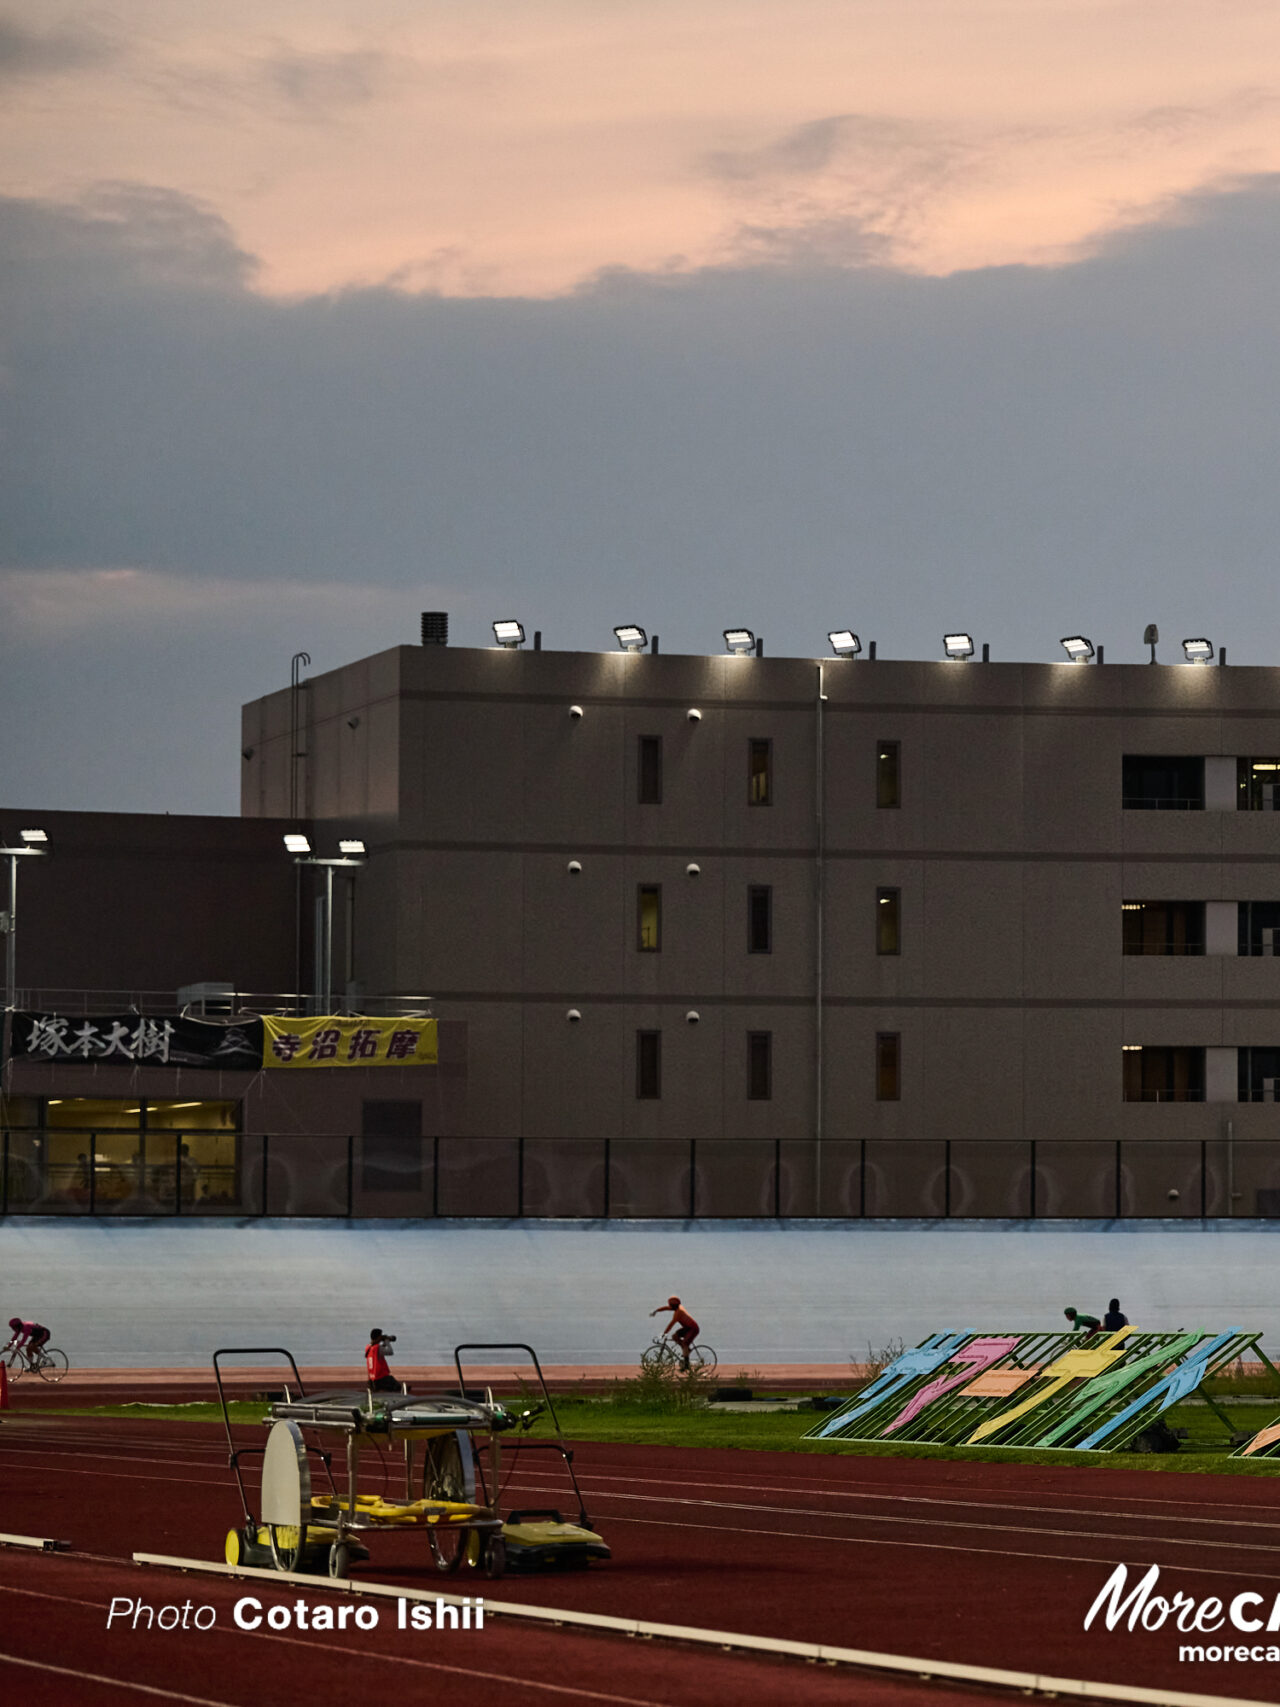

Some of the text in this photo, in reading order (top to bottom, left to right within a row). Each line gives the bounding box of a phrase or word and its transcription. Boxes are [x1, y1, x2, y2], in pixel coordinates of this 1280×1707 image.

[26, 1016, 176, 1063] 塚本大樹
[272, 1029, 421, 1062] 寺沼拓摩
[819, 1325, 1244, 1450] サマーナイト
